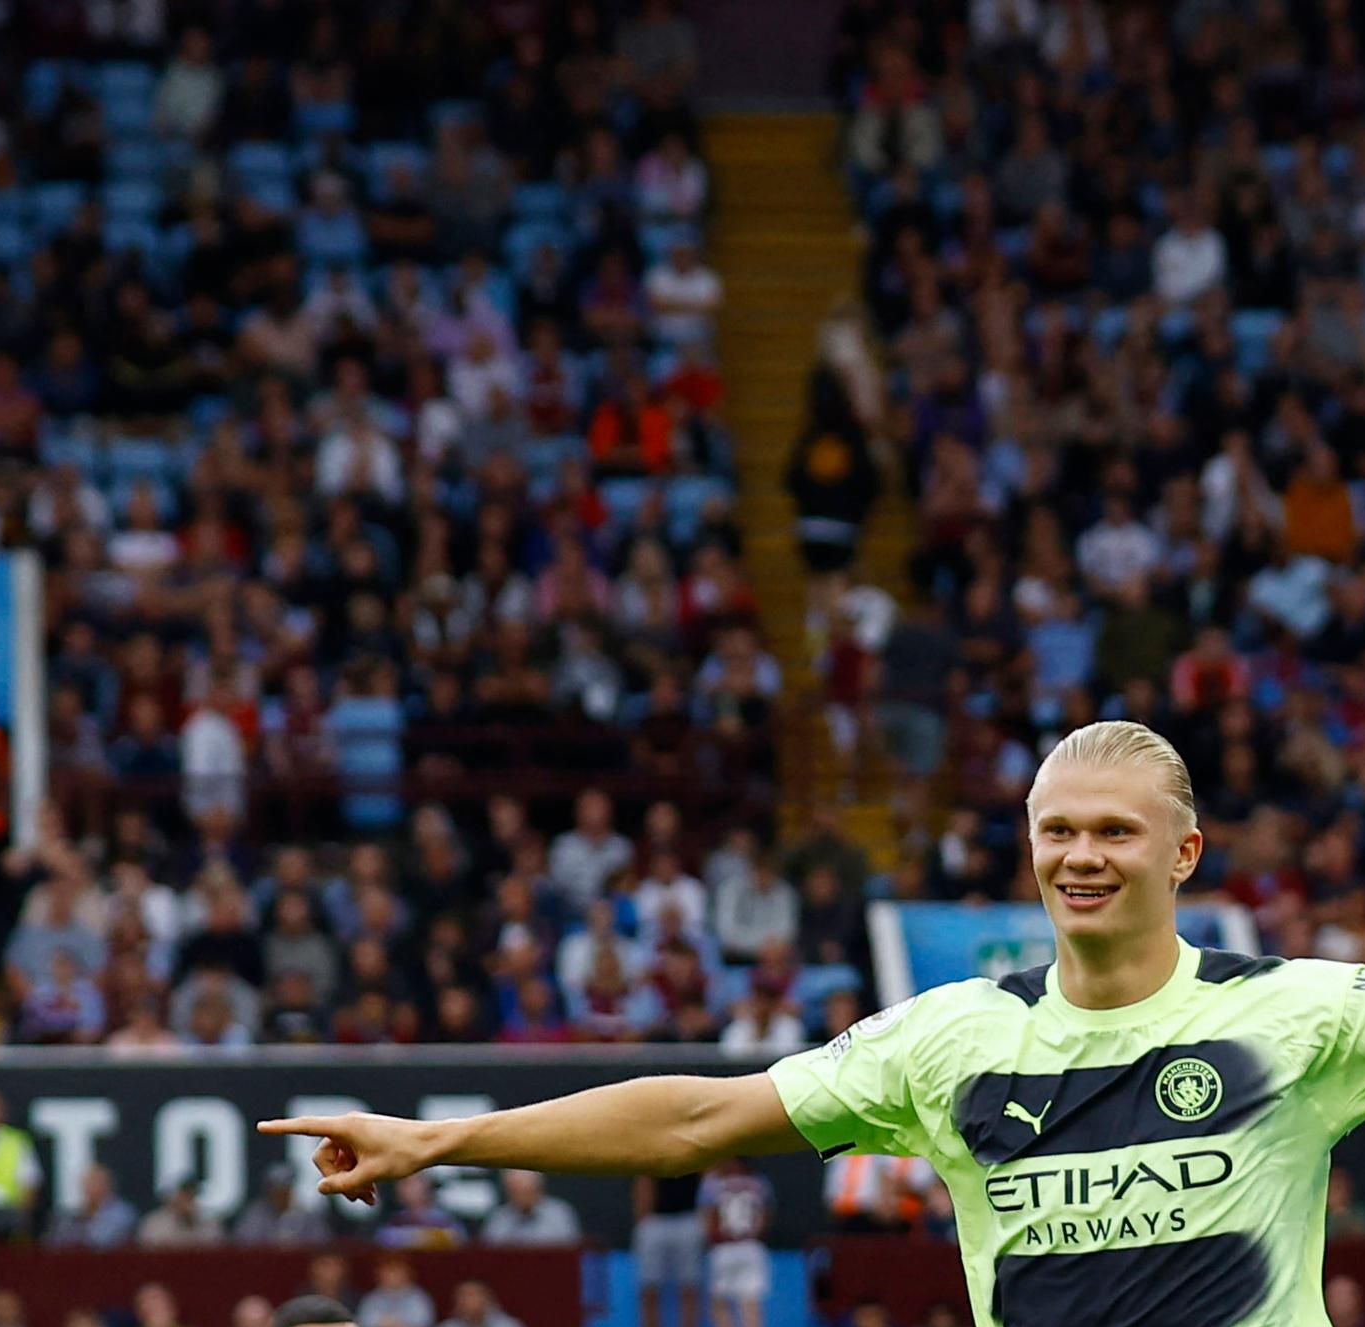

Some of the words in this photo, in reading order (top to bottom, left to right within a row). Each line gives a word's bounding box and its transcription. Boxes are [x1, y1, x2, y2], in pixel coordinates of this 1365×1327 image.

[1180, 1107, 1202, 1117] CITY
[985, 1149, 1231, 1213] ETIHAD
[1025, 1207, 1187, 1246] AIRWAYS
